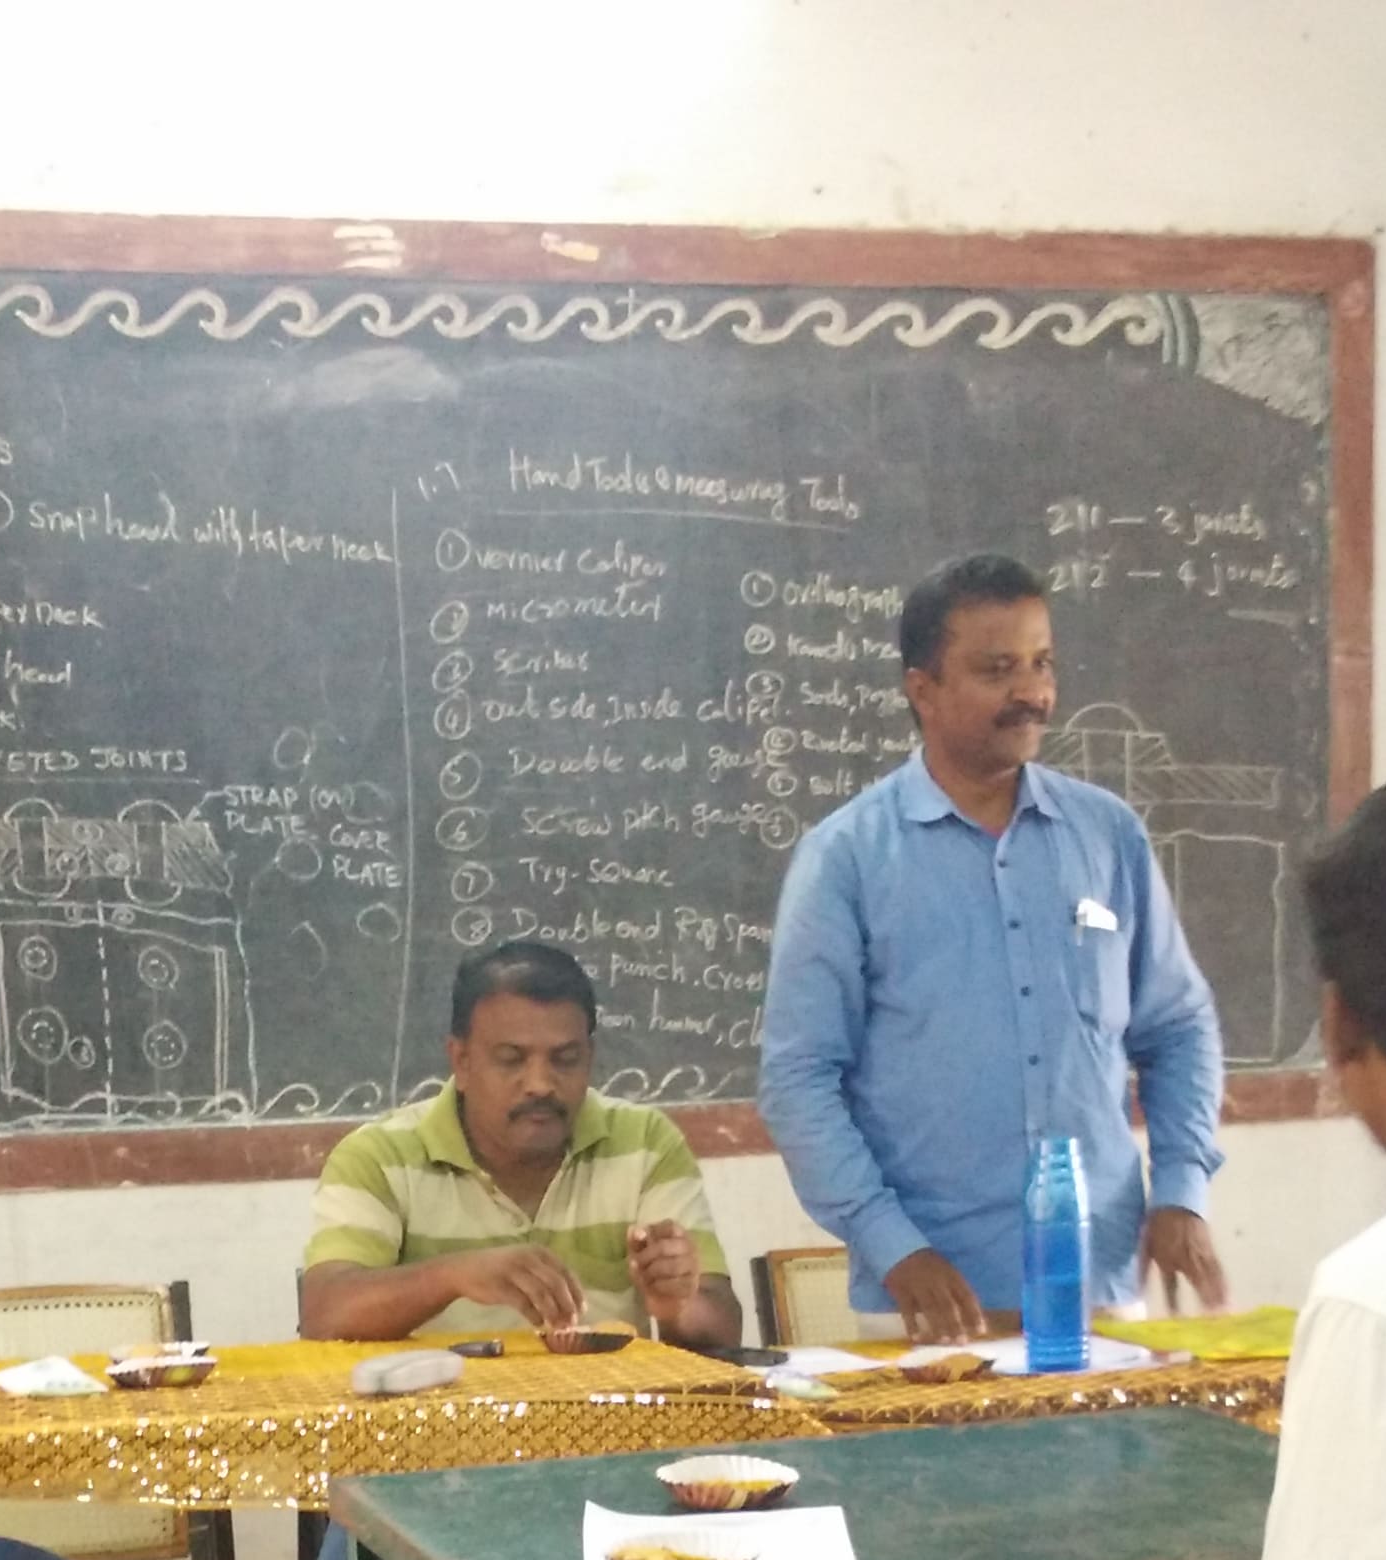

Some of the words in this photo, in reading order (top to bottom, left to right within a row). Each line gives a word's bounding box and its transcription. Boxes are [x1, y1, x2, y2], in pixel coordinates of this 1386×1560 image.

[510, 448, 580, 492] Hand
[28, 503, 99, 543] Snap
[104, 493, 181, 544] head
[1156, 504, 1180, 535] 3
[3, 650, 72, 686] head
[88, 747, 189, 773] JOINTS
[641, 742, 689, 772] end
[222, 784, 299, 812] STRAP
